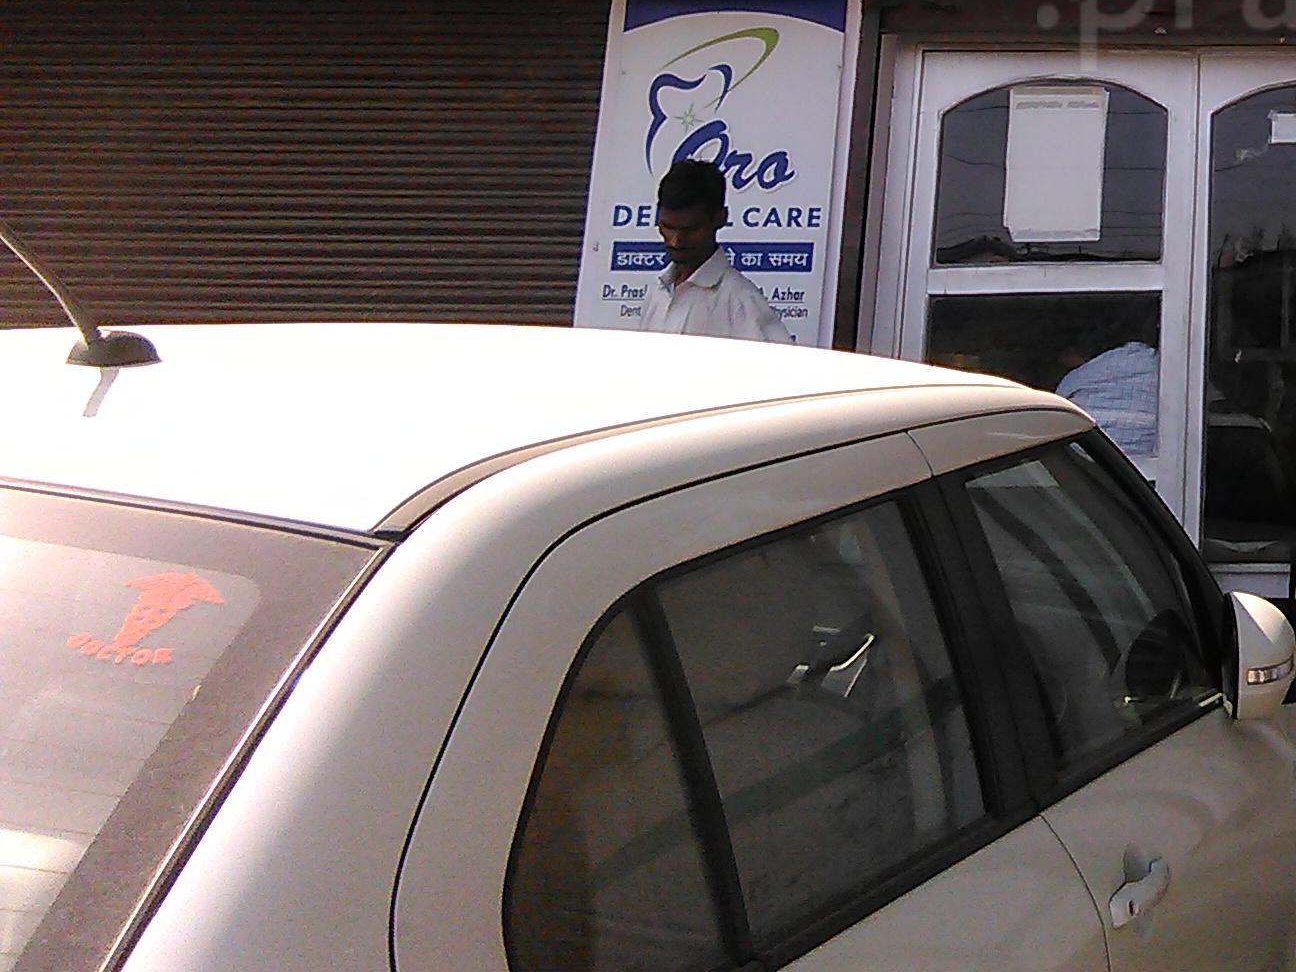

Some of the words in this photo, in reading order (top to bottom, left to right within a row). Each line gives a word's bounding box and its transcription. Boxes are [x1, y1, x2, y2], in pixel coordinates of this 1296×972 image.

[742, 206, 822, 229] CARE
[768, 252, 809, 268] समय
[602, 284, 617, 298] Dr.
[771, 286, 805, 301] Azhar
